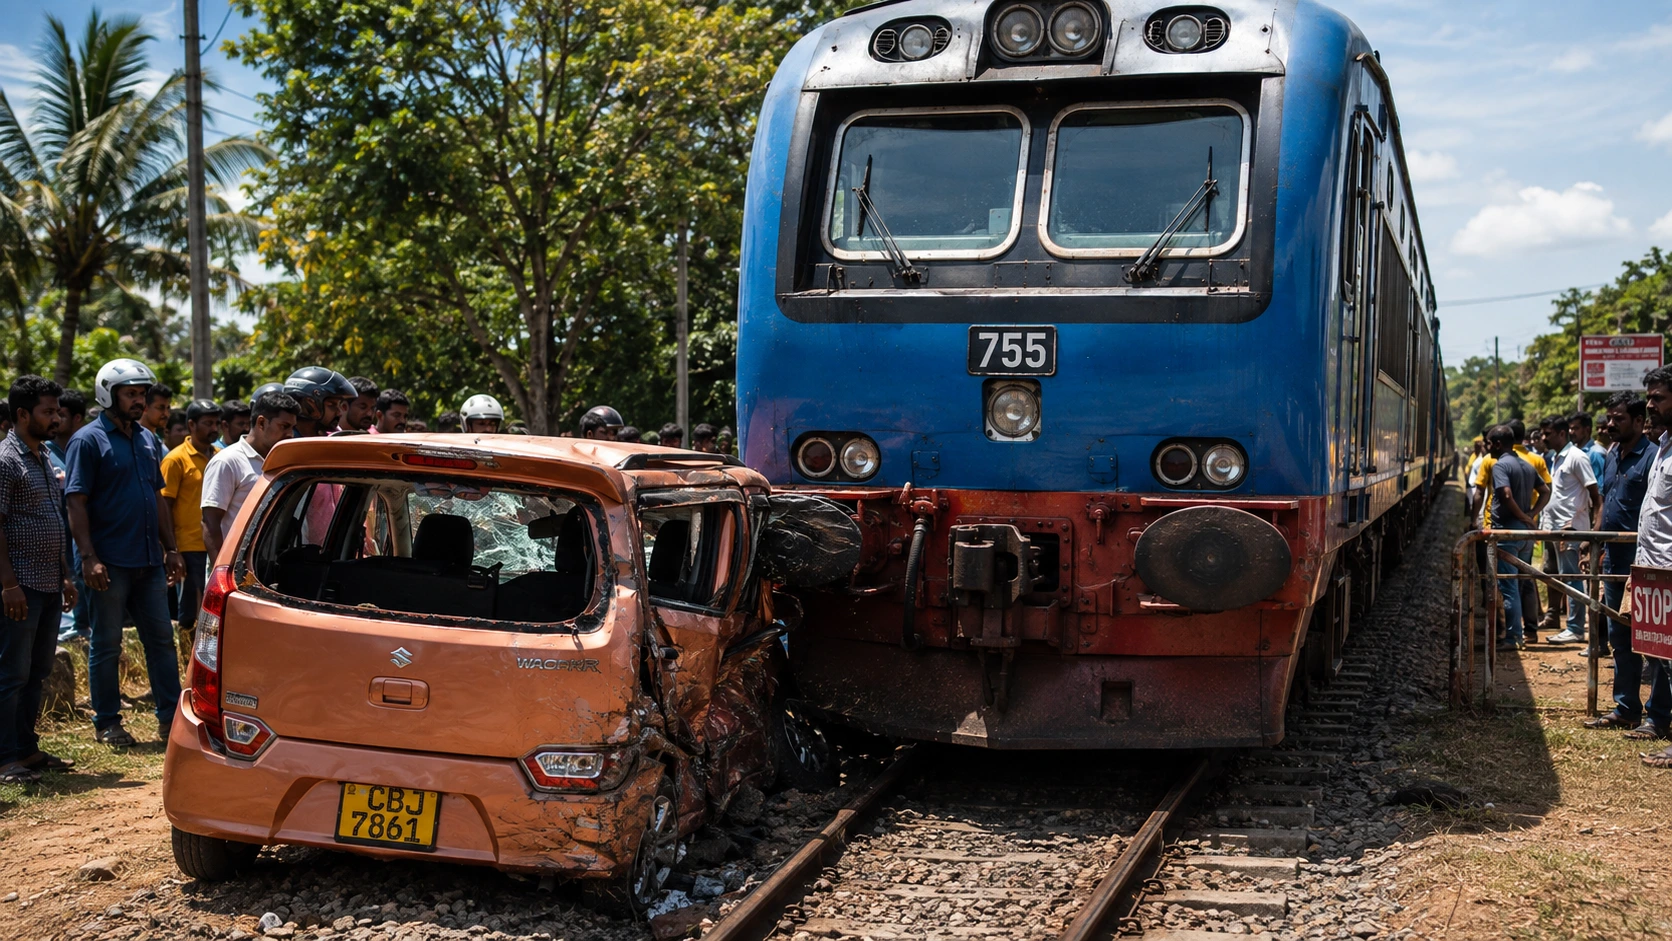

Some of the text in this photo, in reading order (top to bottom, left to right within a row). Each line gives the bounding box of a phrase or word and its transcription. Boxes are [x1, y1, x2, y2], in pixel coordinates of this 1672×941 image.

[979, 332, 1046, 368] 755
[1634, 586, 1672, 625] STOP
[368, 785, 425, 815] CBJ
[352, 811, 420, 843] 7861
